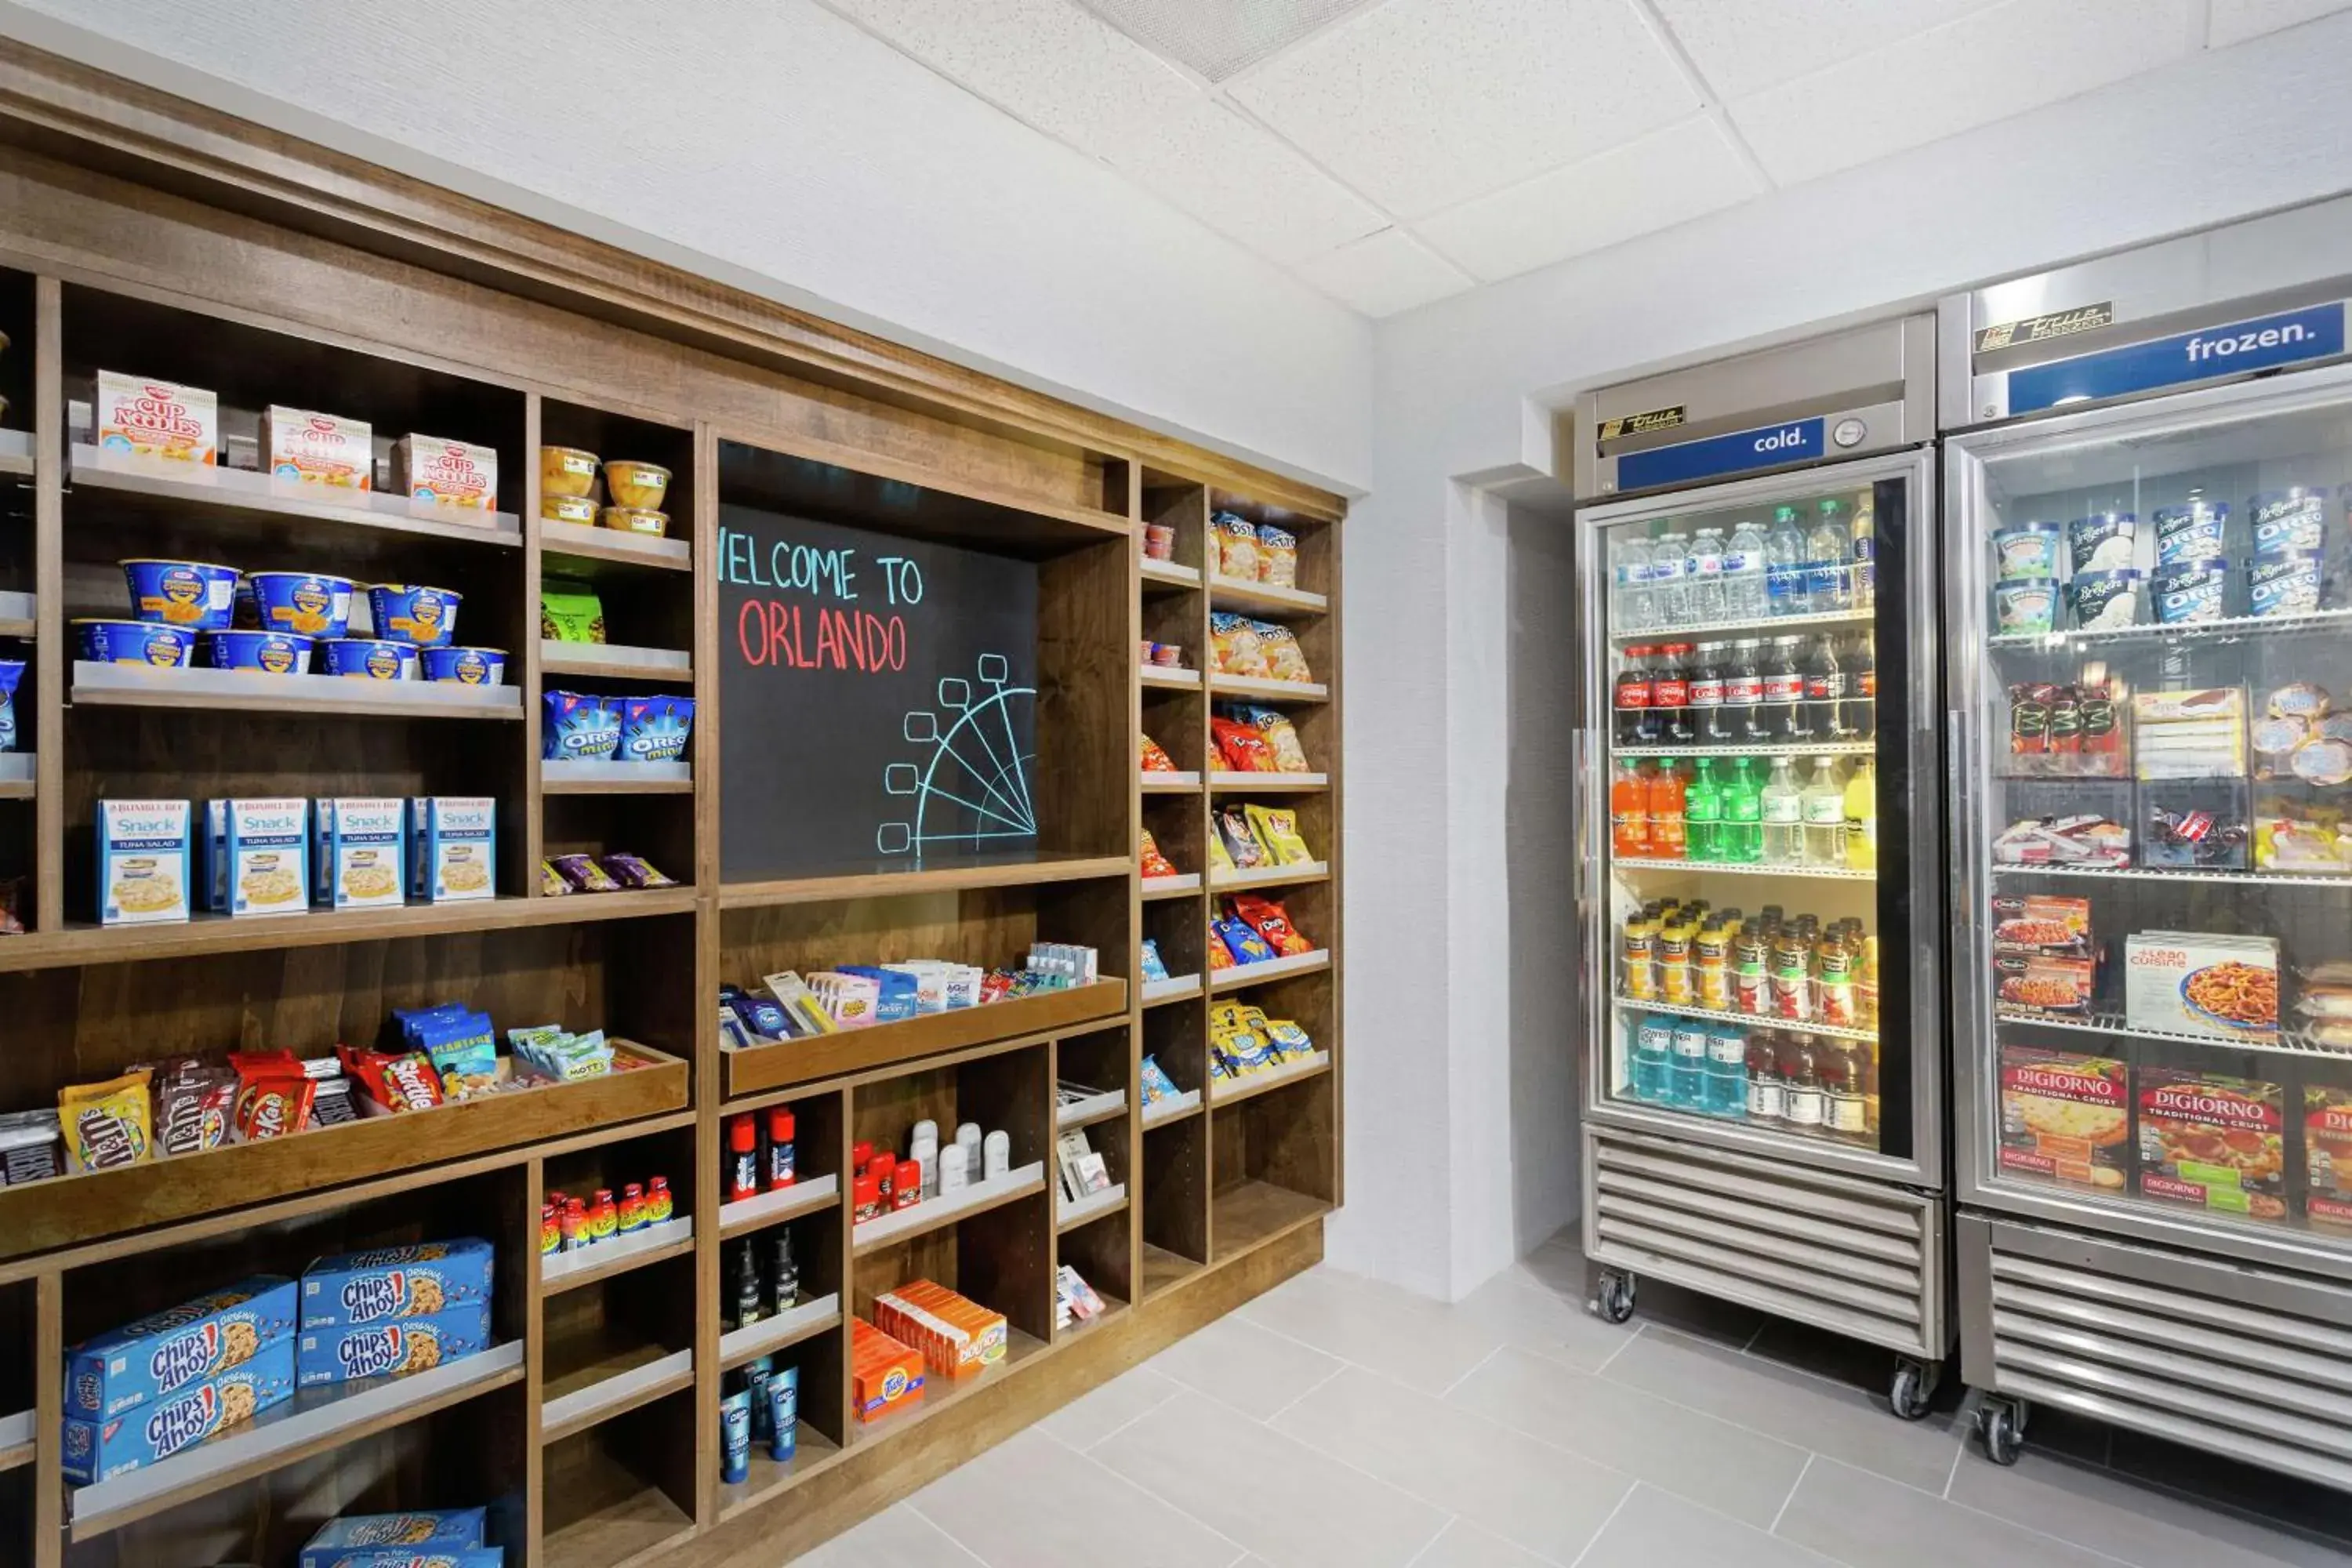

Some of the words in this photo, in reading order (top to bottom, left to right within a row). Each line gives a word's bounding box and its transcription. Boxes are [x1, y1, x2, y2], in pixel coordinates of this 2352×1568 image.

[2186, 323, 2316, 362] frozen.
[136, 398, 186, 419] CUP
[114, 407, 202, 437] NOODLES
[1754, 427, 1807, 453] cold.
[437, 456, 474, 472] CUP
[422, 464, 488, 488] NOODLES
[718, 526, 858, 600] ELCOME
[877, 557, 923, 604] TO
[739, 600, 906, 672] ORLANDO
[565, 729, 621, 750] OREO
[579, 741, 615, 756] mini
[632, 735, 686, 753] OREO
[646, 746, 682, 760] mini
[118, 818, 176, 833] Snack
[245, 816, 296, 830] Snack
[346, 815, 393, 828] Snack
[443, 812, 485, 825] Snack
[387, 1058, 434, 1110] Skittle
[2016, 1069, 2112, 1096] DIGIORNO
[2012, 1083, 2078, 1100] TRADITIONAL
[2083, 1095, 2118, 1106] CRUST
[2156, 1091, 2264, 1120] DIGIORNO
[2148, 1108, 2227, 1126] TRADITIONAL
[2230, 1120, 2270, 1131] CRUST
[2147, 1178, 2201, 1196] DIGIORNO
[343, 1276, 392, 1307] Chips
[152, 1331, 205, 1377] Chips
[339, 1331, 389, 1362] Chips
[147, 1393, 202, 1443] Chips
